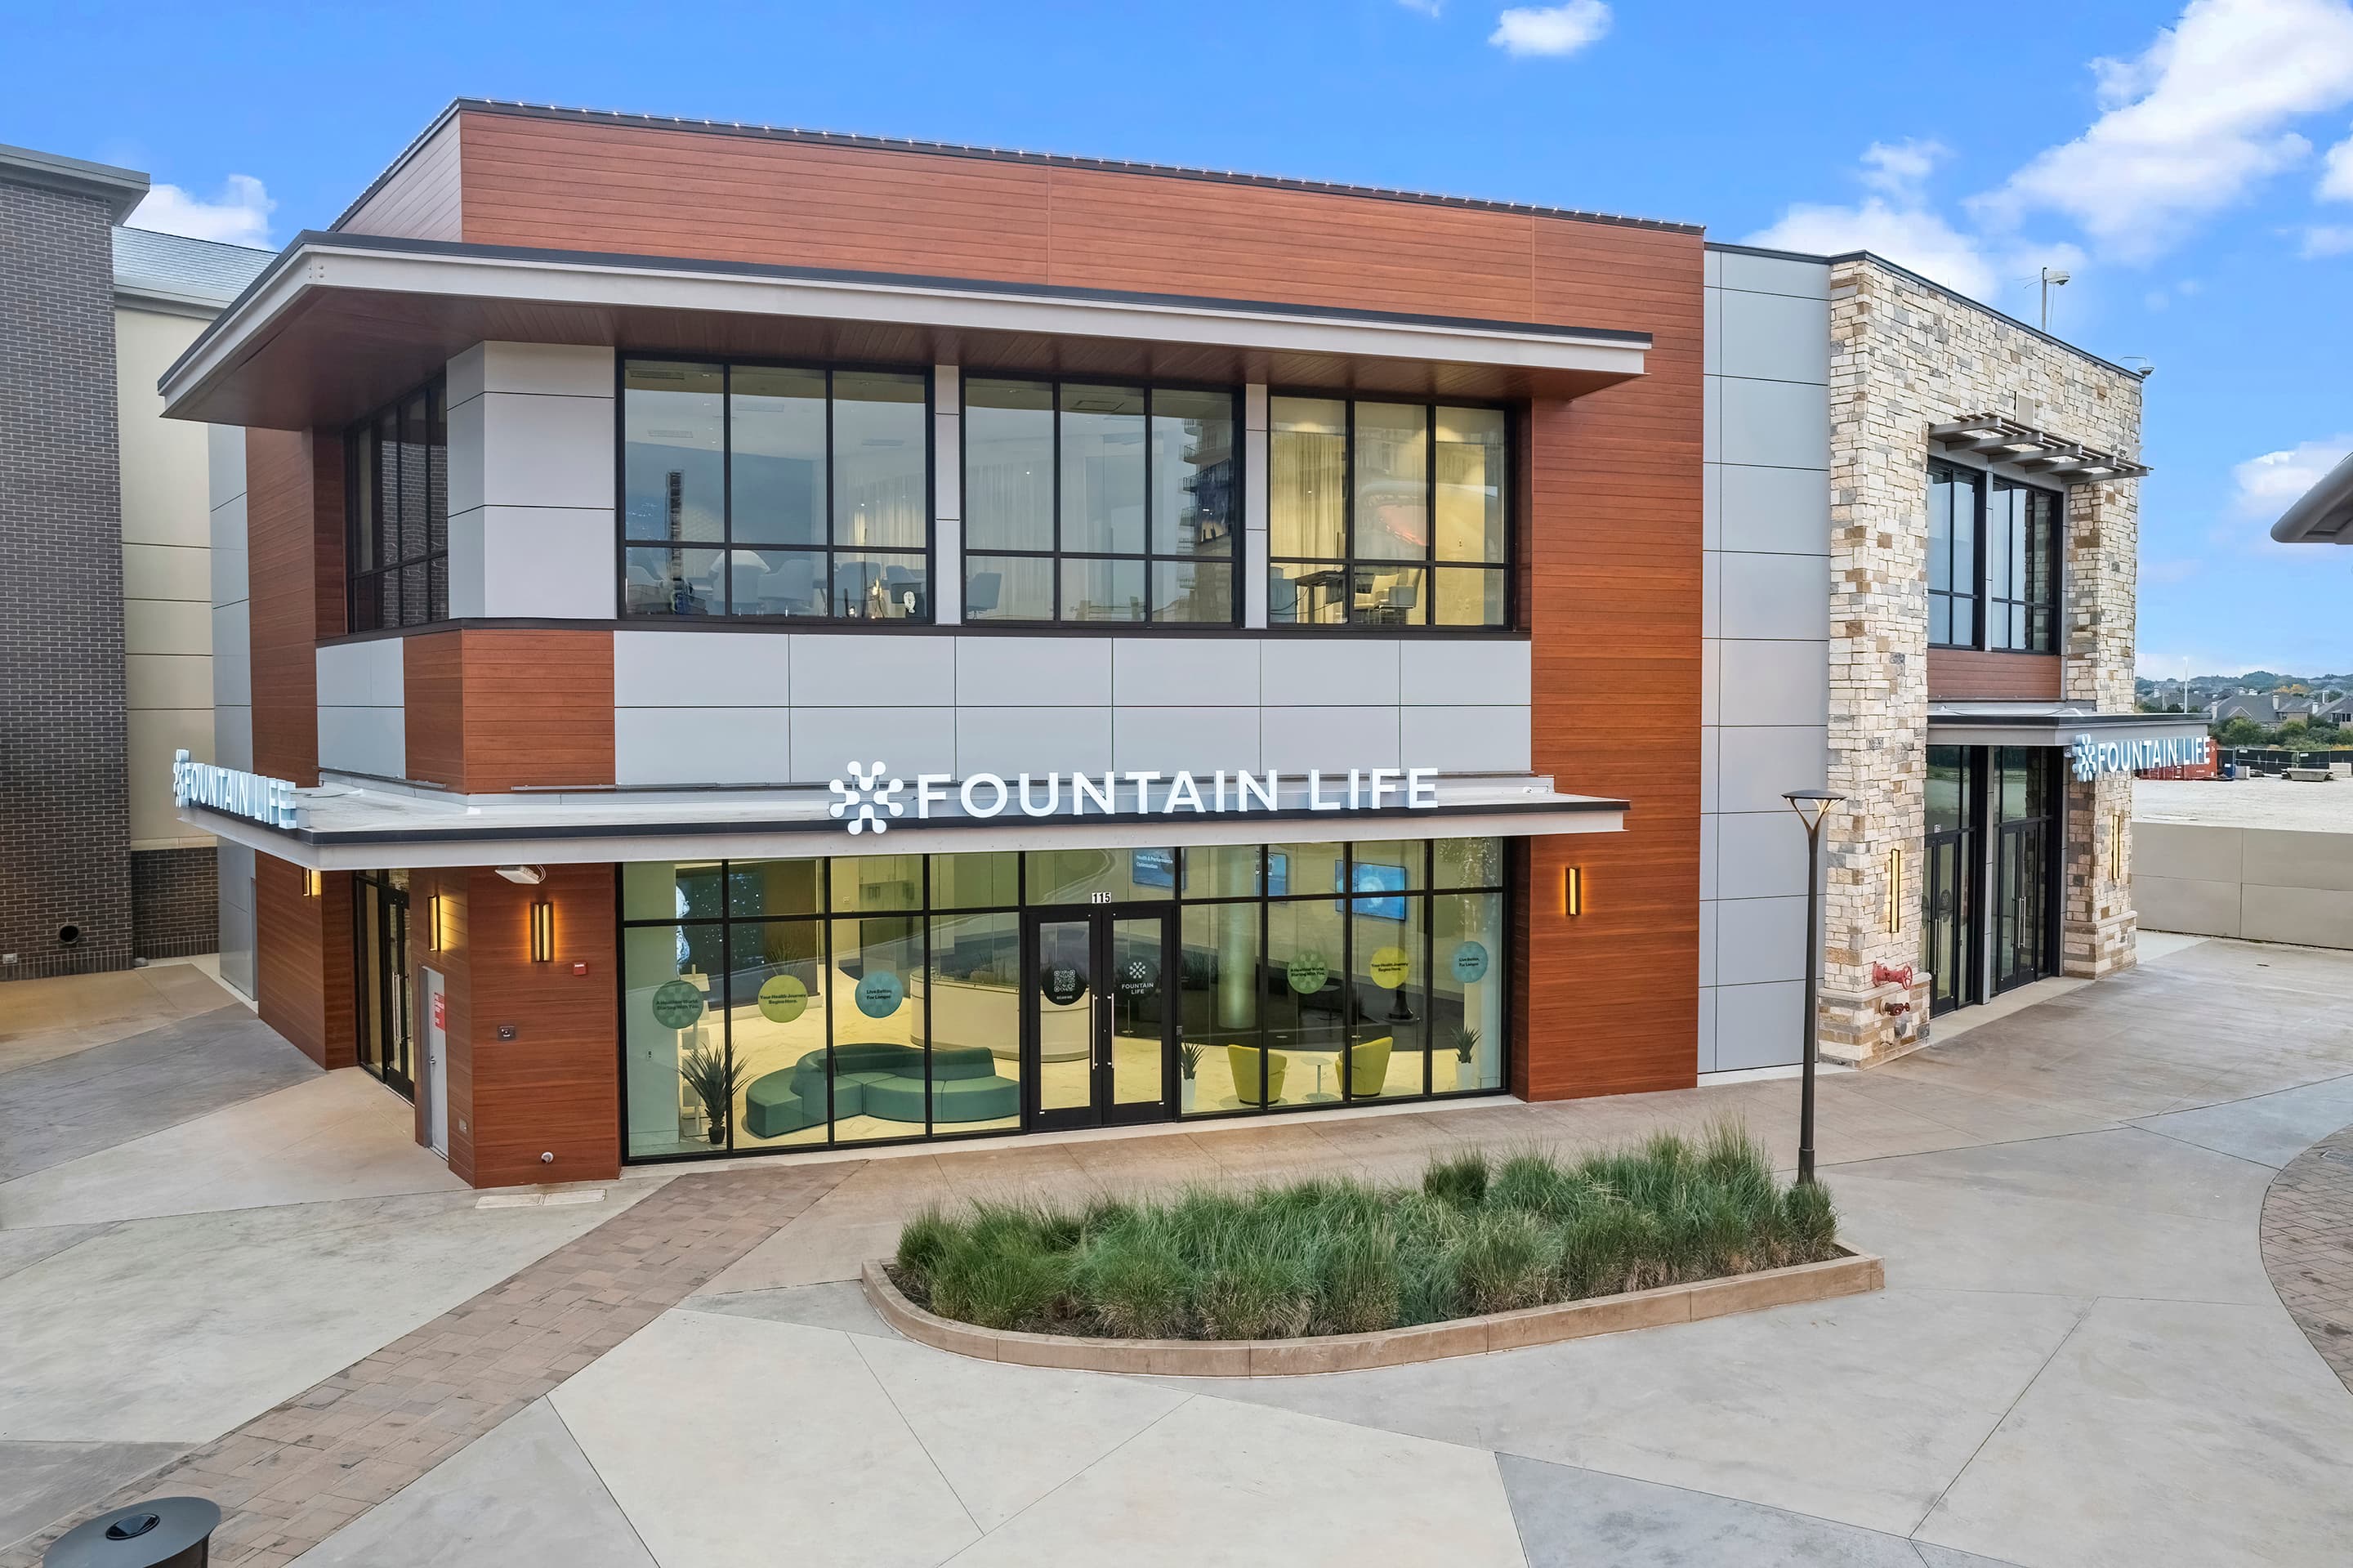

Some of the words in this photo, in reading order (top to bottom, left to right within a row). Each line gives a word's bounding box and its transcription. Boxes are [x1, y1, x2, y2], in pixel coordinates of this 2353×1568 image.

[2098, 739, 2177, 774] FOUNTAIN
[2183, 736, 2210, 765] LIFE
[185, 762, 255, 816] FOUNTAIN
[255, 775, 297, 829] LIFE
[917, 770, 1278, 819] FOUNTAIN
[1308, 768, 1439, 811] LIFE
[1093, 893, 1110, 903] 115
